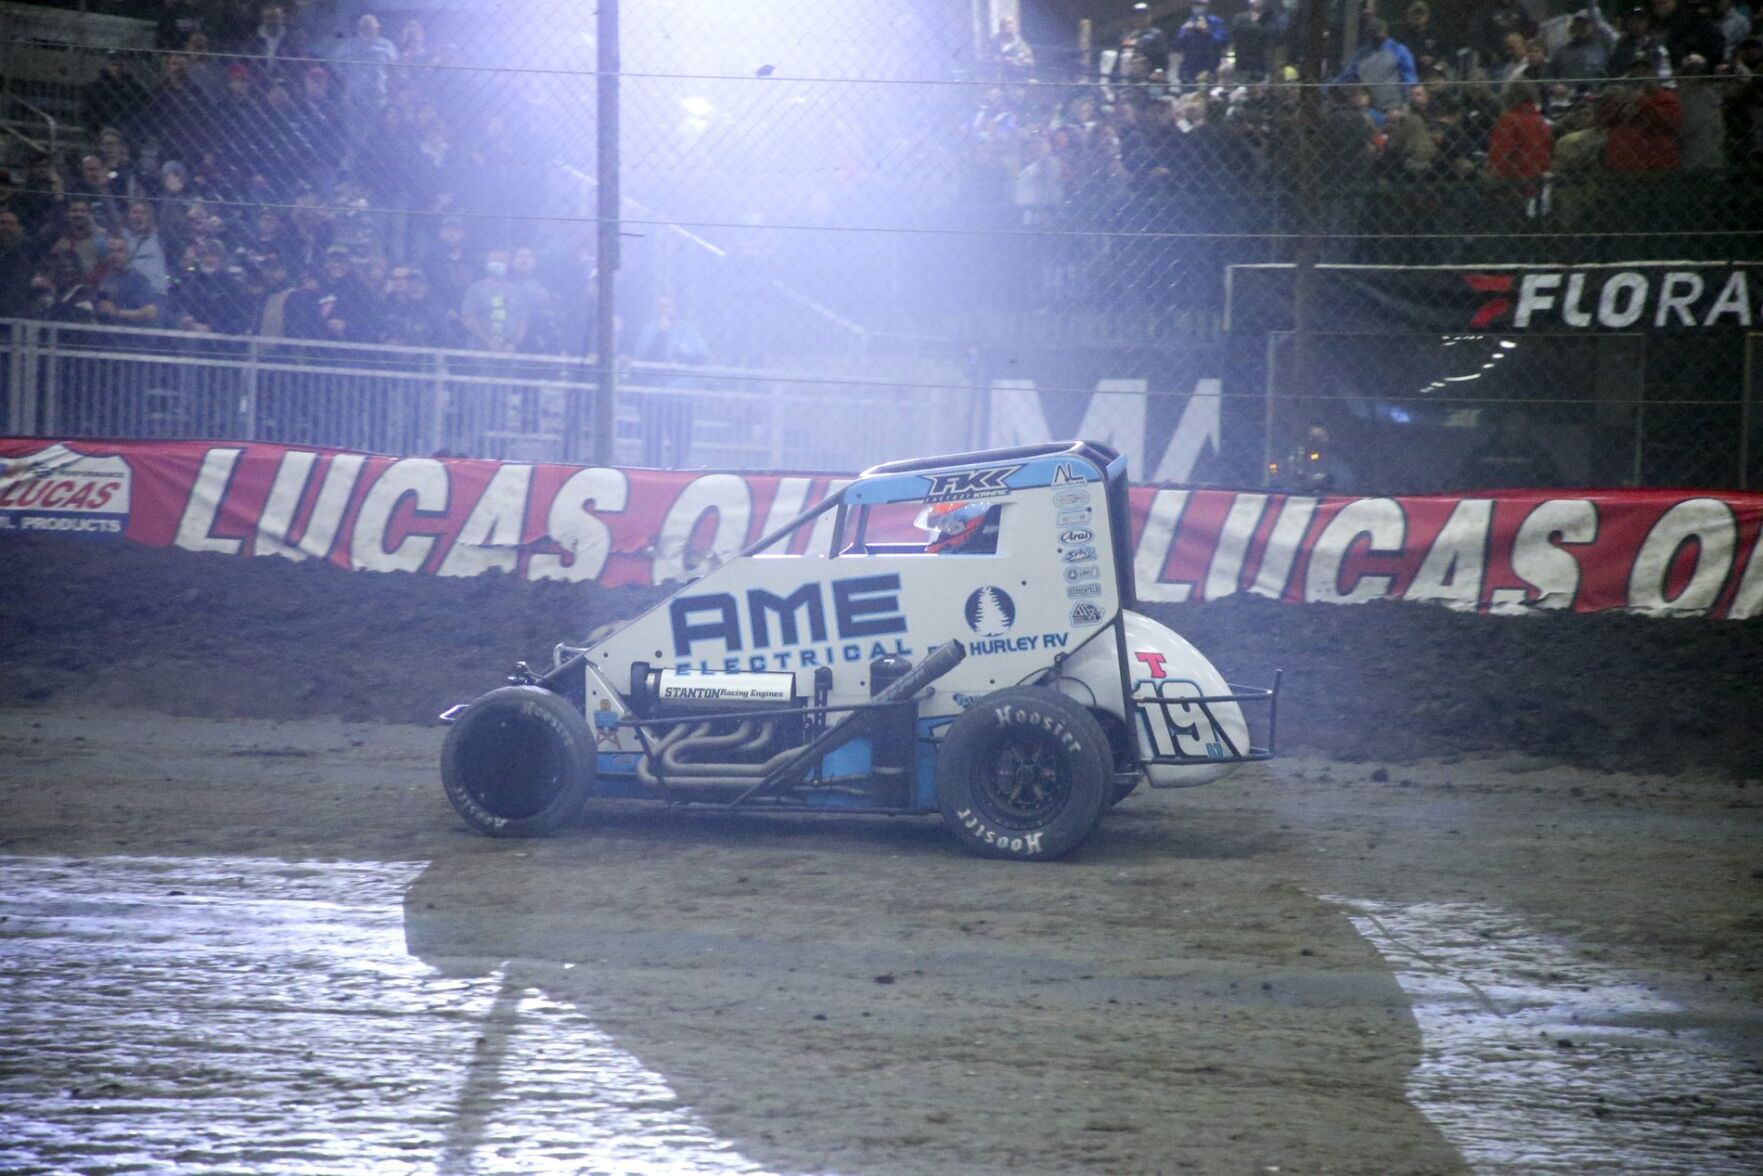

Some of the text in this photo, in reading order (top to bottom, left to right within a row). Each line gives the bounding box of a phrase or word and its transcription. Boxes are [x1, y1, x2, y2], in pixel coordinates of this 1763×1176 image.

[1513, 271, 1763, 328] FLORA
[0, 479, 121, 509] LUCAS
[173, 447, 628, 583] LUCAS
[21, 516, 121, 533] PRODUCTS
[1133, 489, 1598, 614] LUCAS
[669, 574, 906, 657] AME
[674, 637, 912, 676] ELECTRICAL
[970, 633, 1069, 656] HURLEY RV
[1134, 652, 1167, 678] T
[664, 687, 784, 698] STANTON Racing Engines
[995, 705, 1082, 751] Hoosier
[957, 808, 1043, 855] Hoosier
